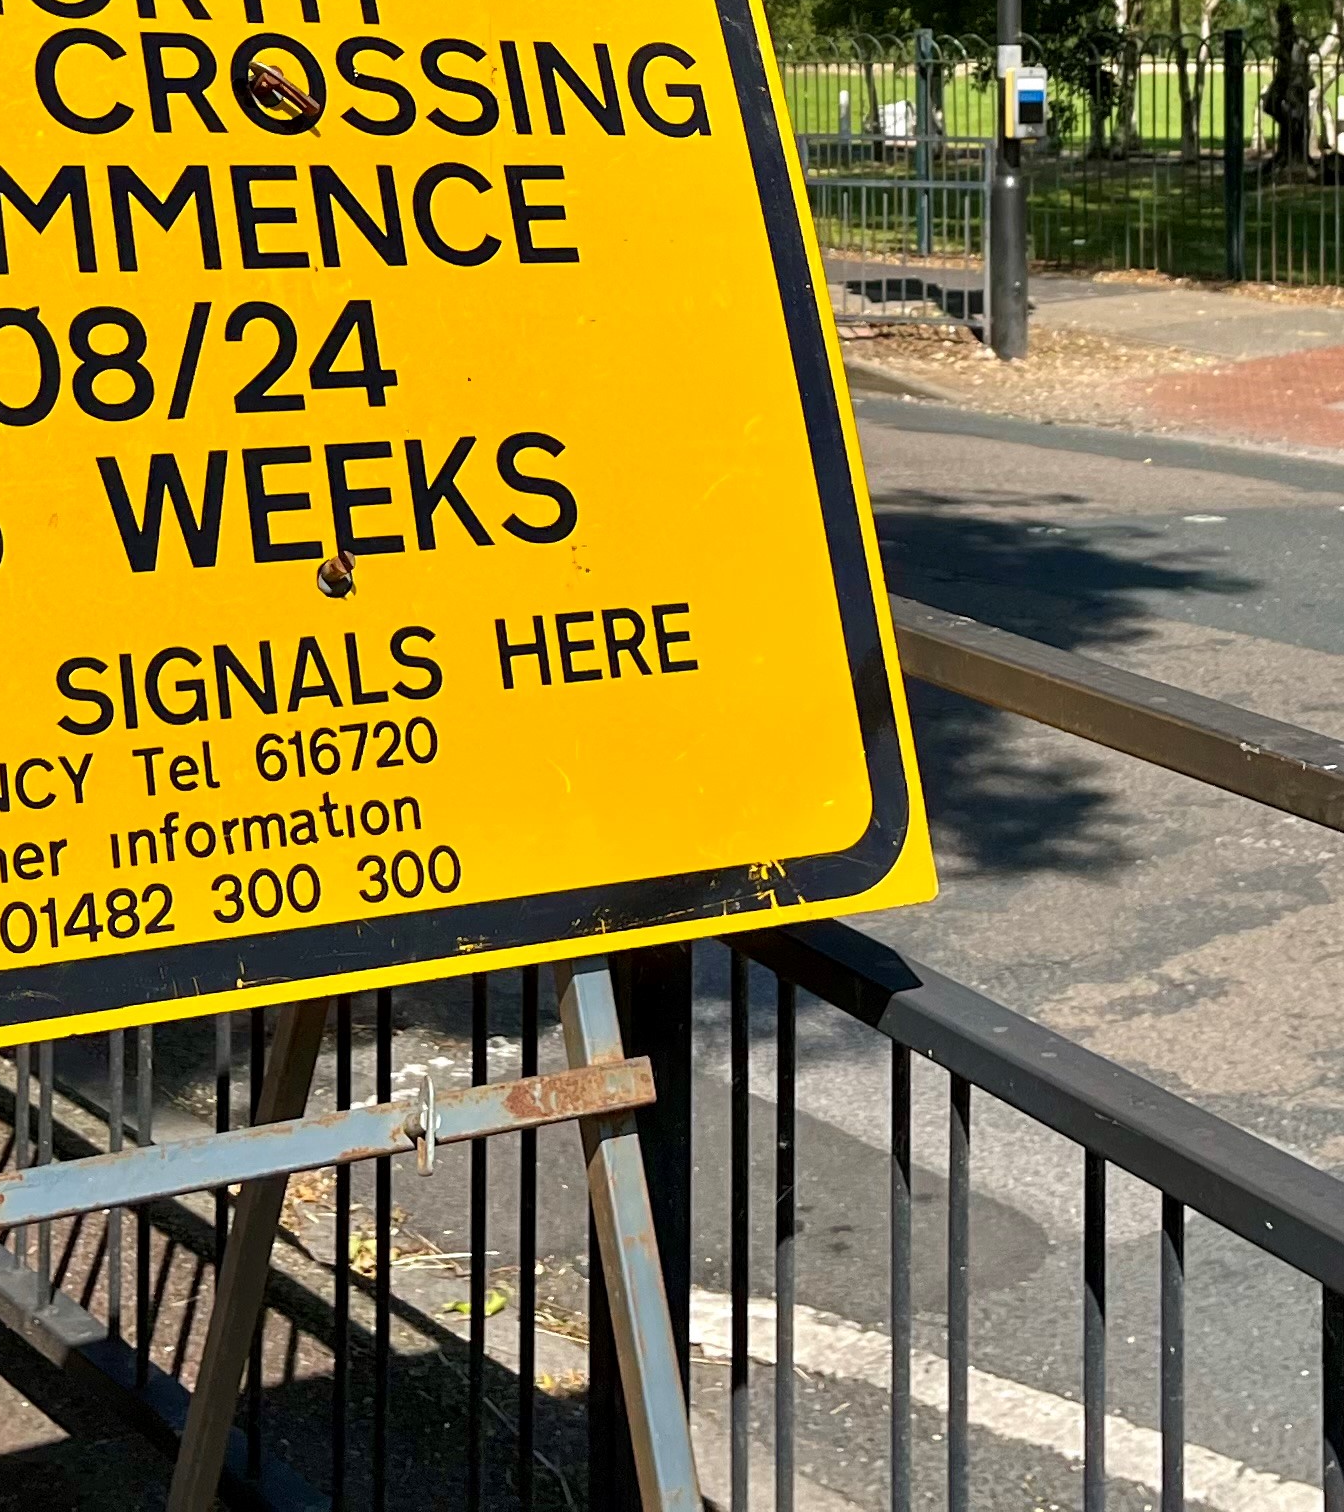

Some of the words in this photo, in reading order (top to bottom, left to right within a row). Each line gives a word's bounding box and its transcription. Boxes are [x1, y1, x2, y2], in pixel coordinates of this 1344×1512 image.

[35, 28, 711, 138] CROSSING
[96, 432, 577, 573] WEEKS
[56, 626, 442, 735] SIGNALS
[495, 603, 698, 689] HERE
[133, 742, 220, 795] Tel
[256, 717, 437, 781] 616720
[111, 792, 421, 868] information
[0, 884, 174, 953] 01482
[212, 864, 320, 923] 300
[358, 846, 460, 903] 300
